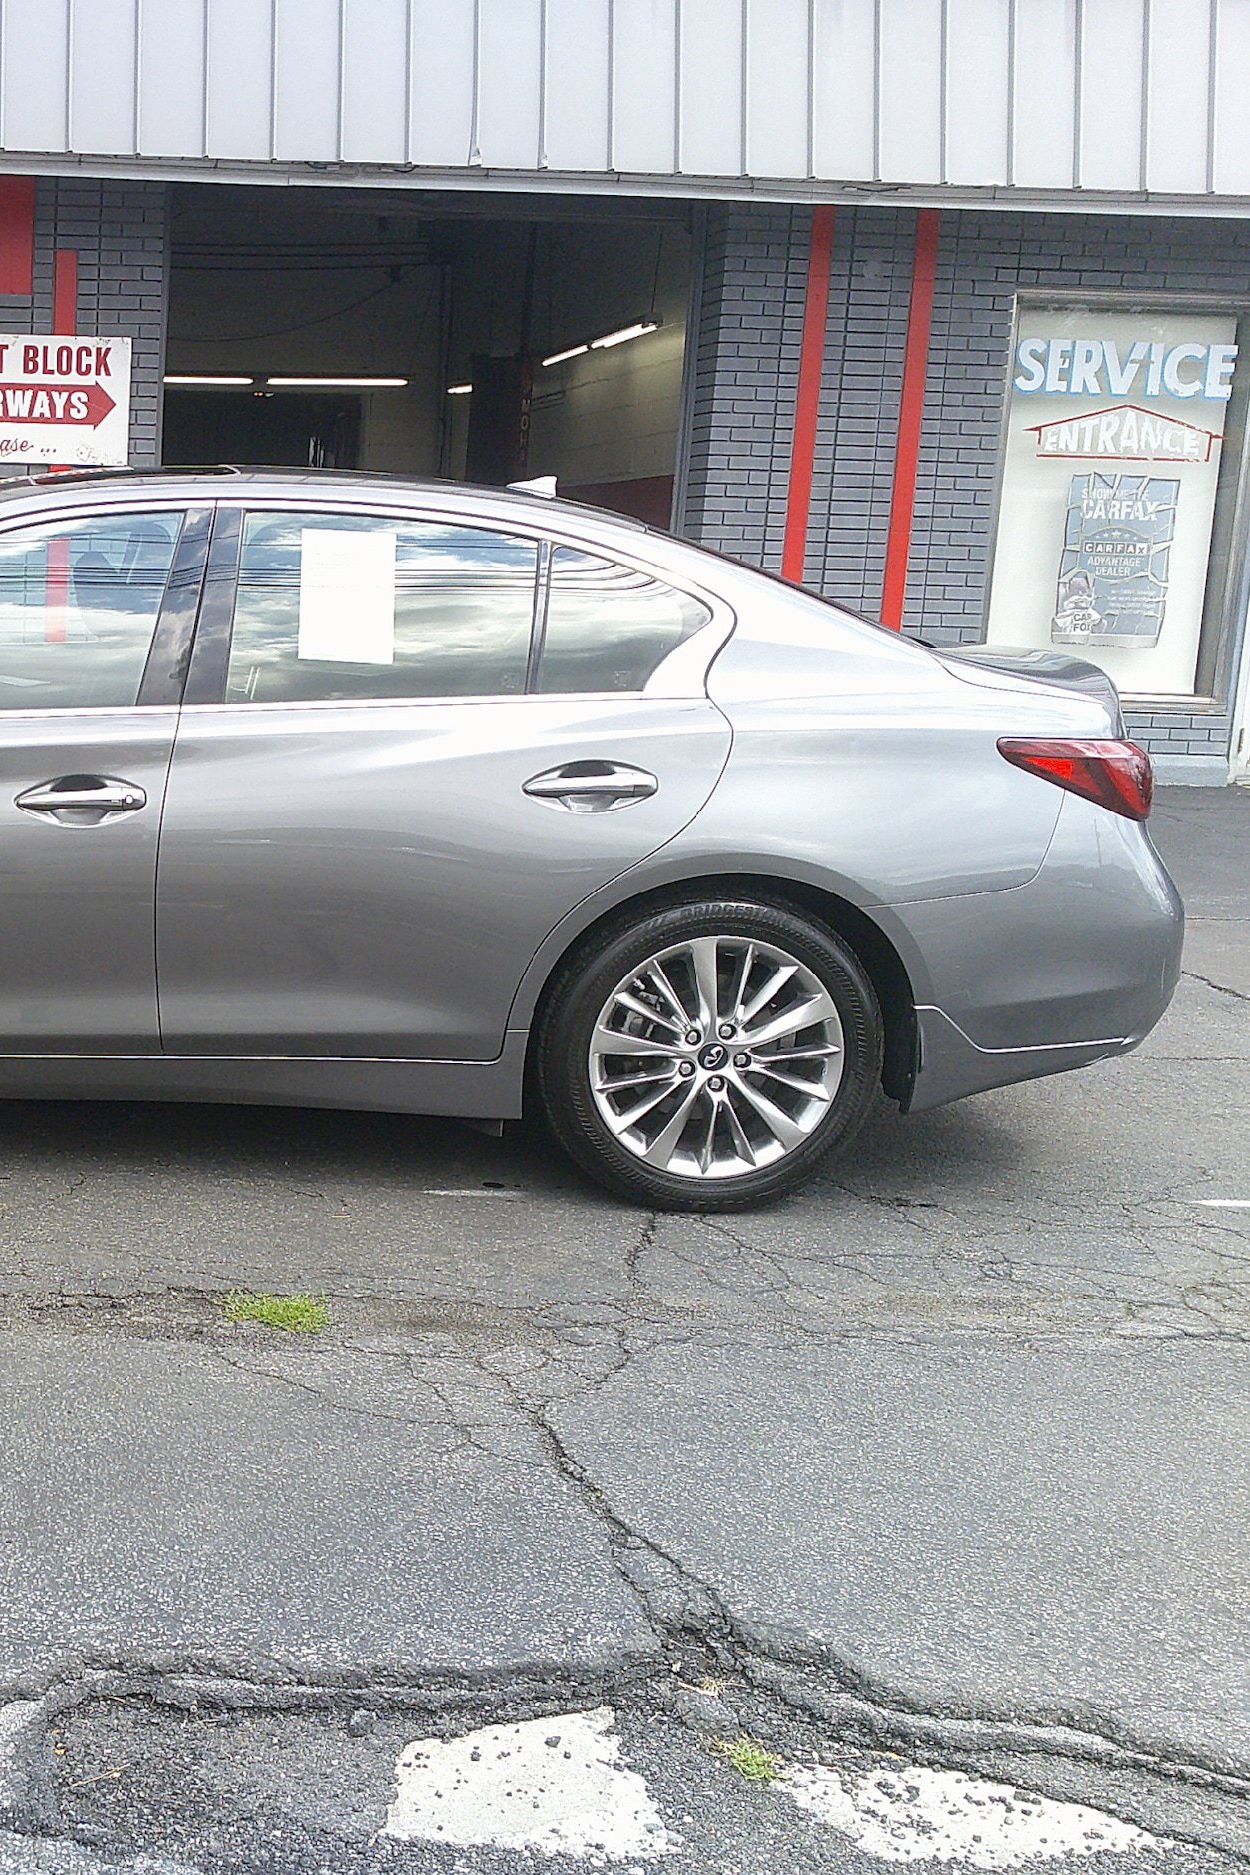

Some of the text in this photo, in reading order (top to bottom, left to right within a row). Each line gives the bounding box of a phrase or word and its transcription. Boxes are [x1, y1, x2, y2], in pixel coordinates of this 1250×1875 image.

[23, 345, 112, 376] BLOCK
[1014, 338, 1239, 400] SERVICE
[1043, 410, 1199, 456] ENTRANCE
[1080, 500, 1159, 521] CARFAX
[1084, 542, 1148, 555] CARFAX
[1087, 556, 1141, 567] ADVANTAGE
[1095, 567, 1131, 576] DEALER
